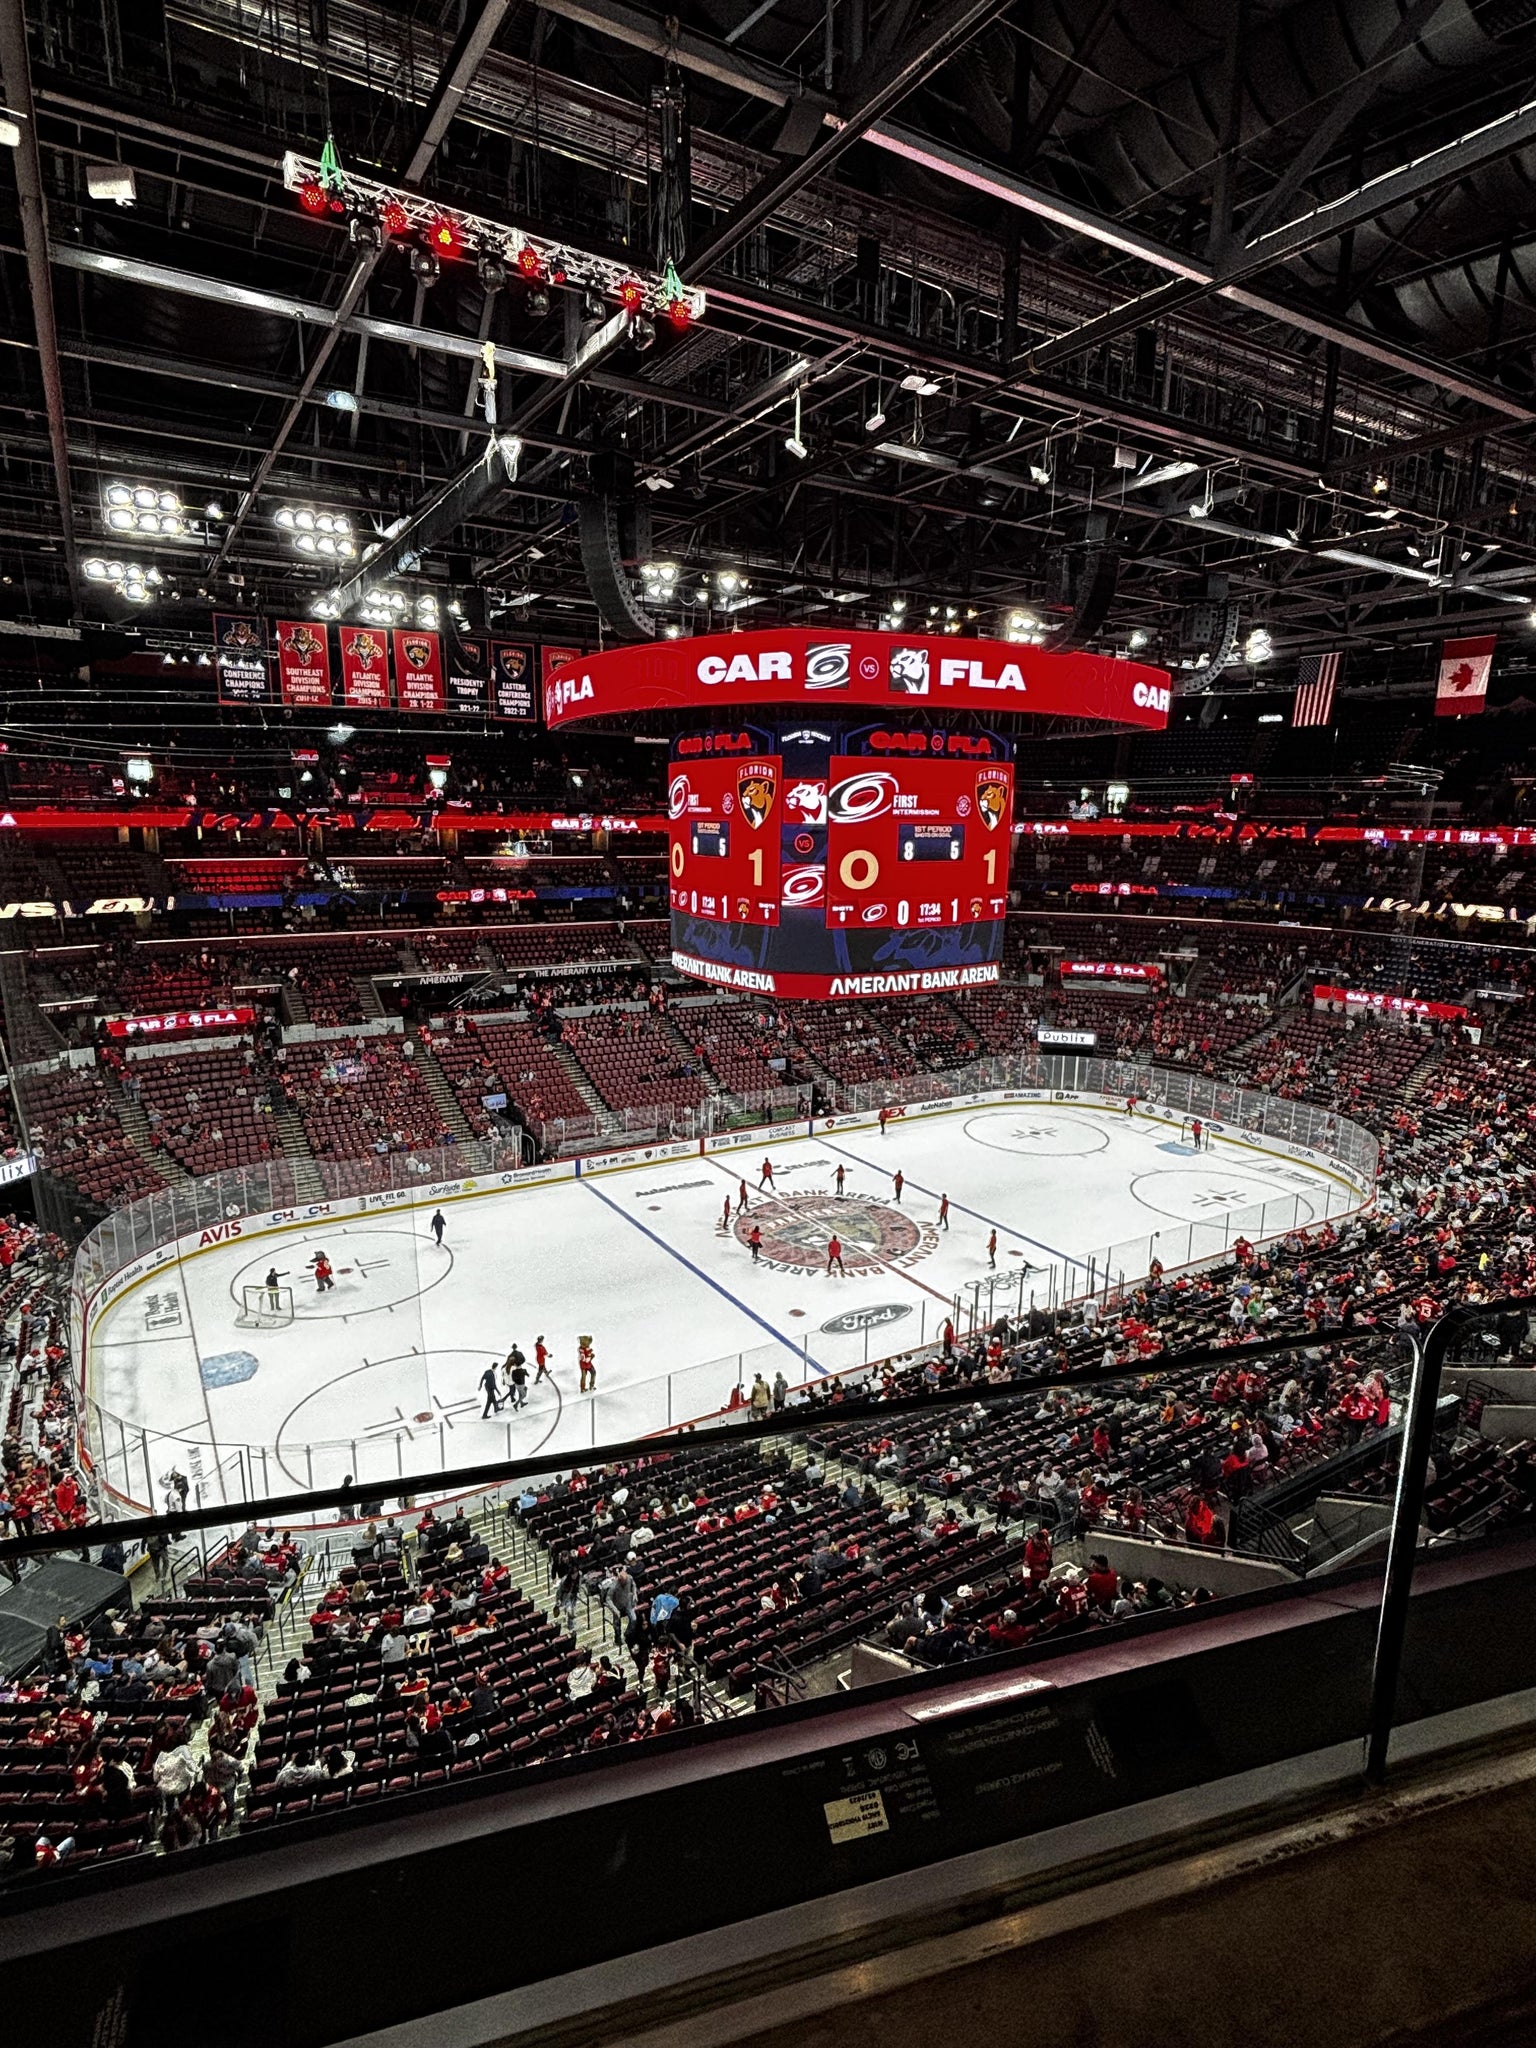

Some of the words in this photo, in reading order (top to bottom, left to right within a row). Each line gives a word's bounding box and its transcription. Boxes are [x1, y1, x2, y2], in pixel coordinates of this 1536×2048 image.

[223, 669, 266, 681] CONFERENCE
[286, 667, 324, 677] SOUTHEAST
[352, 671, 381, 681] ATLANTIC
[697, 651, 793, 685] CAR
[863, 664, 876, 674] VS
[940, 658, 1027, 691] FLA
[290, 676, 321, 685] DIVISION
[405, 673, 434, 682] ATLANTIC
[225, 679, 265, 690] CHAMPIONS
[286, 684, 326, 694] CHAMPIONS
[353, 680, 381, 689] DIVISION
[406, 682, 434, 691] DIVISION
[456, 685, 479, 696] TROPHY
[502, 682, 527, 691] EASTERN
[563, 675, 595, 705] FLA
[350, 688, 386, 698] CHAMPIONS
[402, 690, 439, 700] CHAMPIONS
[498, 690, 532, 699] CONFERENCE
[1132, 682, 1170, 713] CAR
[499, 698, 531, 708] CHAMPIONS
[503, 707, 527, 716] 2022-23
[714, 732, 752, 750] FLA
[948, 735, 992, 754] FLA
[739, 765, 774, 779] FLORIDA
[978, 769, 1008, 783] FLORIDA
[893, 794, 919, 808] FIRST
[892, 808, 940, 816] INTERMISSION
[551, 819, 580, 829] CAR
[613, 819, 639, 830] FLA
[927, 825, 953, 833] PERIOD
[1045, 825, 1070, 834] FLA
[718, 837, 727, 857] 5
[798, 840, 810, 848] VS
[903, 841, 914, 861] 8
[950, 841, 960, 860] 5
[672, 842, 685, 878] 0
[748, 848, 763, 887] 1
[840, 849, 880, 890] 0
[983, 849, 996, 885] 1
[1070, 883, 1098, 893] CAR
[436, 893, 469, 901] CAR
[507, 890, 537, 900] FLA
[691, 890, 698, 914] 0
[721, 895, 728, 919] 1
[897, 900, 910, 925] 0
[919, 903, 942, 916] 17:34
[951, 898, 959, 922] 1
[534, 969, 550, 977] THE
[550, 967, 590, 977] AMERANT
[591, 965, 618, 974] VAULT
[672, 950, 706, 977] AMERANT
[705, 962, 733, 984] BANK
[732, 968, 776, 993] ARENA
[1122, 967, 1146, 976] FLA
[419, 975, 464, 985] AMERANT
[829, 973, 921, 995] AMERANT
[921, 968, 961, 989] BANK
[959, 964, 999, 984] ARENA
[204, 1013, 237, 1024] FLA
[125, 1020, 161, 1033] CAR
[1043, 1032, 1087, 1044] Publix
[920, 1099, 953, 1112] AutoNation
[768, 1124, 796, 1134] COMCAST
[768, 1130, 796, 1140] BUSINESS
[428, 1182, 461, 1197] Surfside
[778, 1189, 829, 1198] BANK
[846, 1191, 891, 1205] RENA
[308, 1203, 331, 1215] CH
[272, 1210, 295, 1222] CH
[199, 1221, 243, 1248] AVIS
[124, 1264, 143, 1282] Health
[752, 1257, 819, 1278] ARENA
[841, 1306, 896, 1331] Ford
